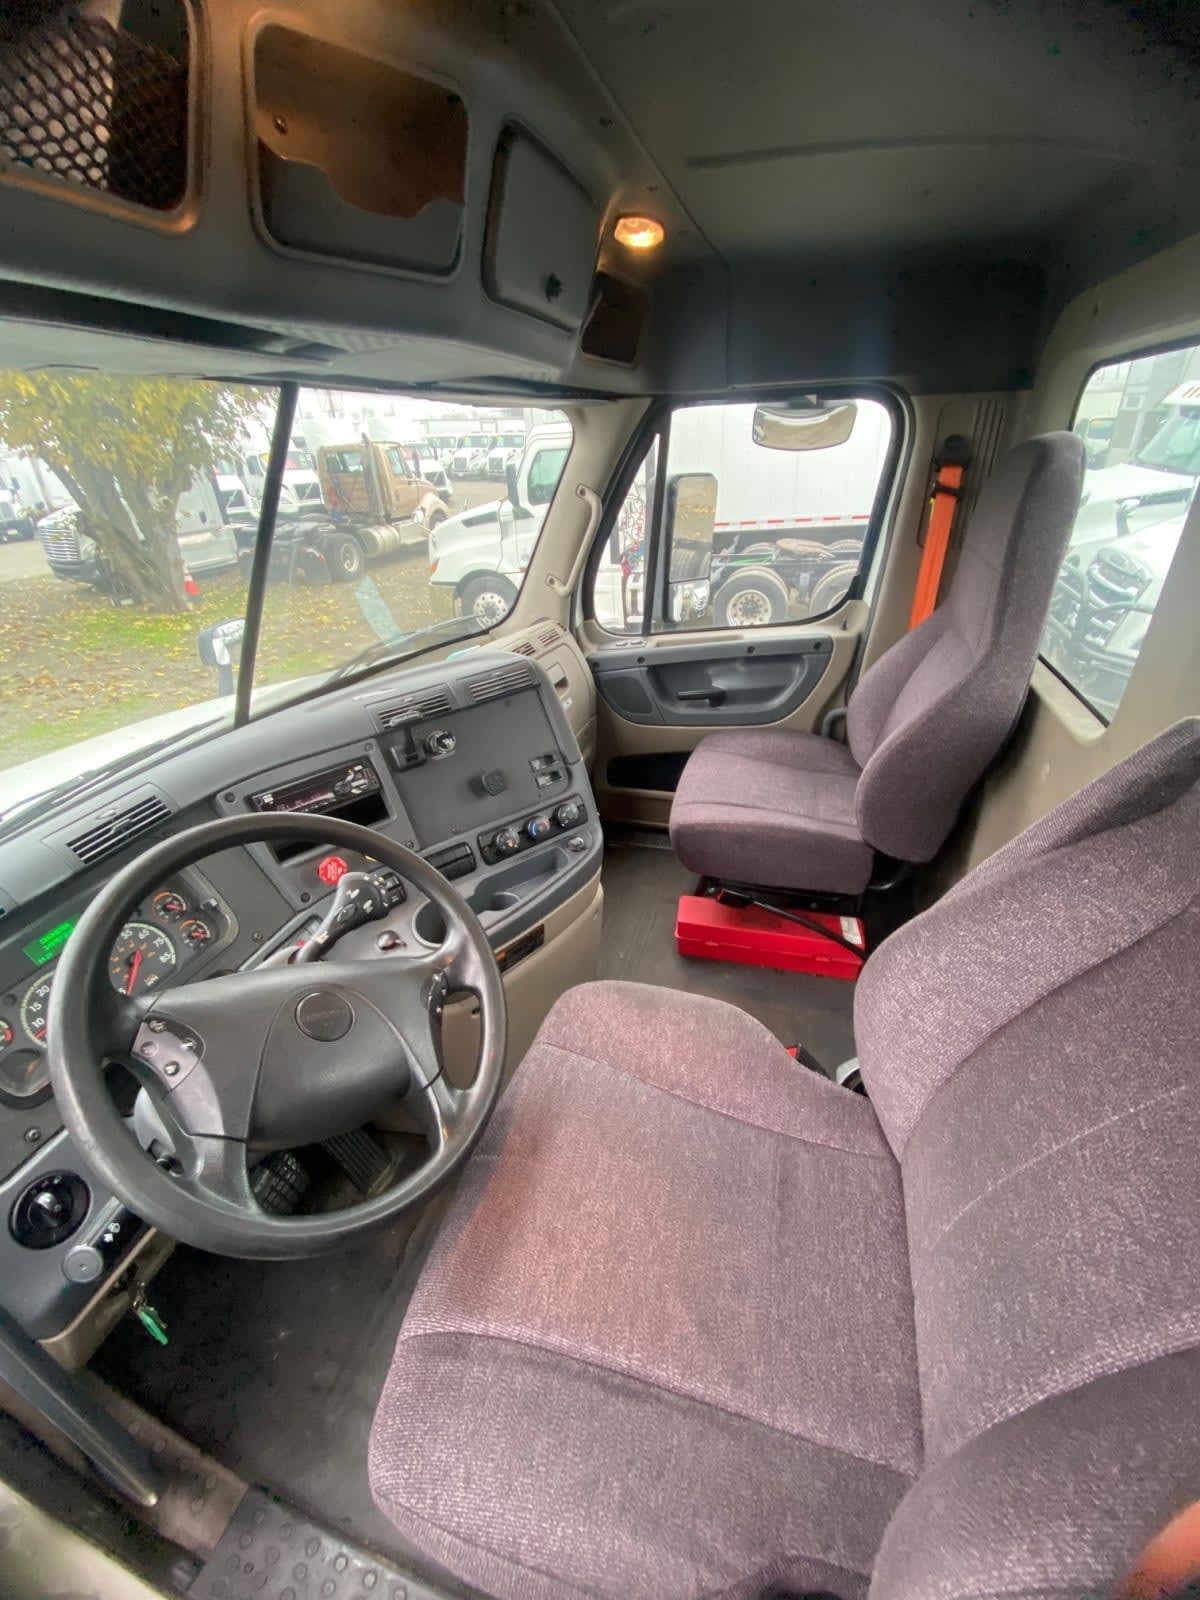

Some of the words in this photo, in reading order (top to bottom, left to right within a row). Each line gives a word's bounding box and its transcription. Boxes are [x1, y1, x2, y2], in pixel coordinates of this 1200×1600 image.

[36, 985, 49, 998] 20
[29, 1002, 42, 1012] 15
[32, 1017, 45, 1028] 10
